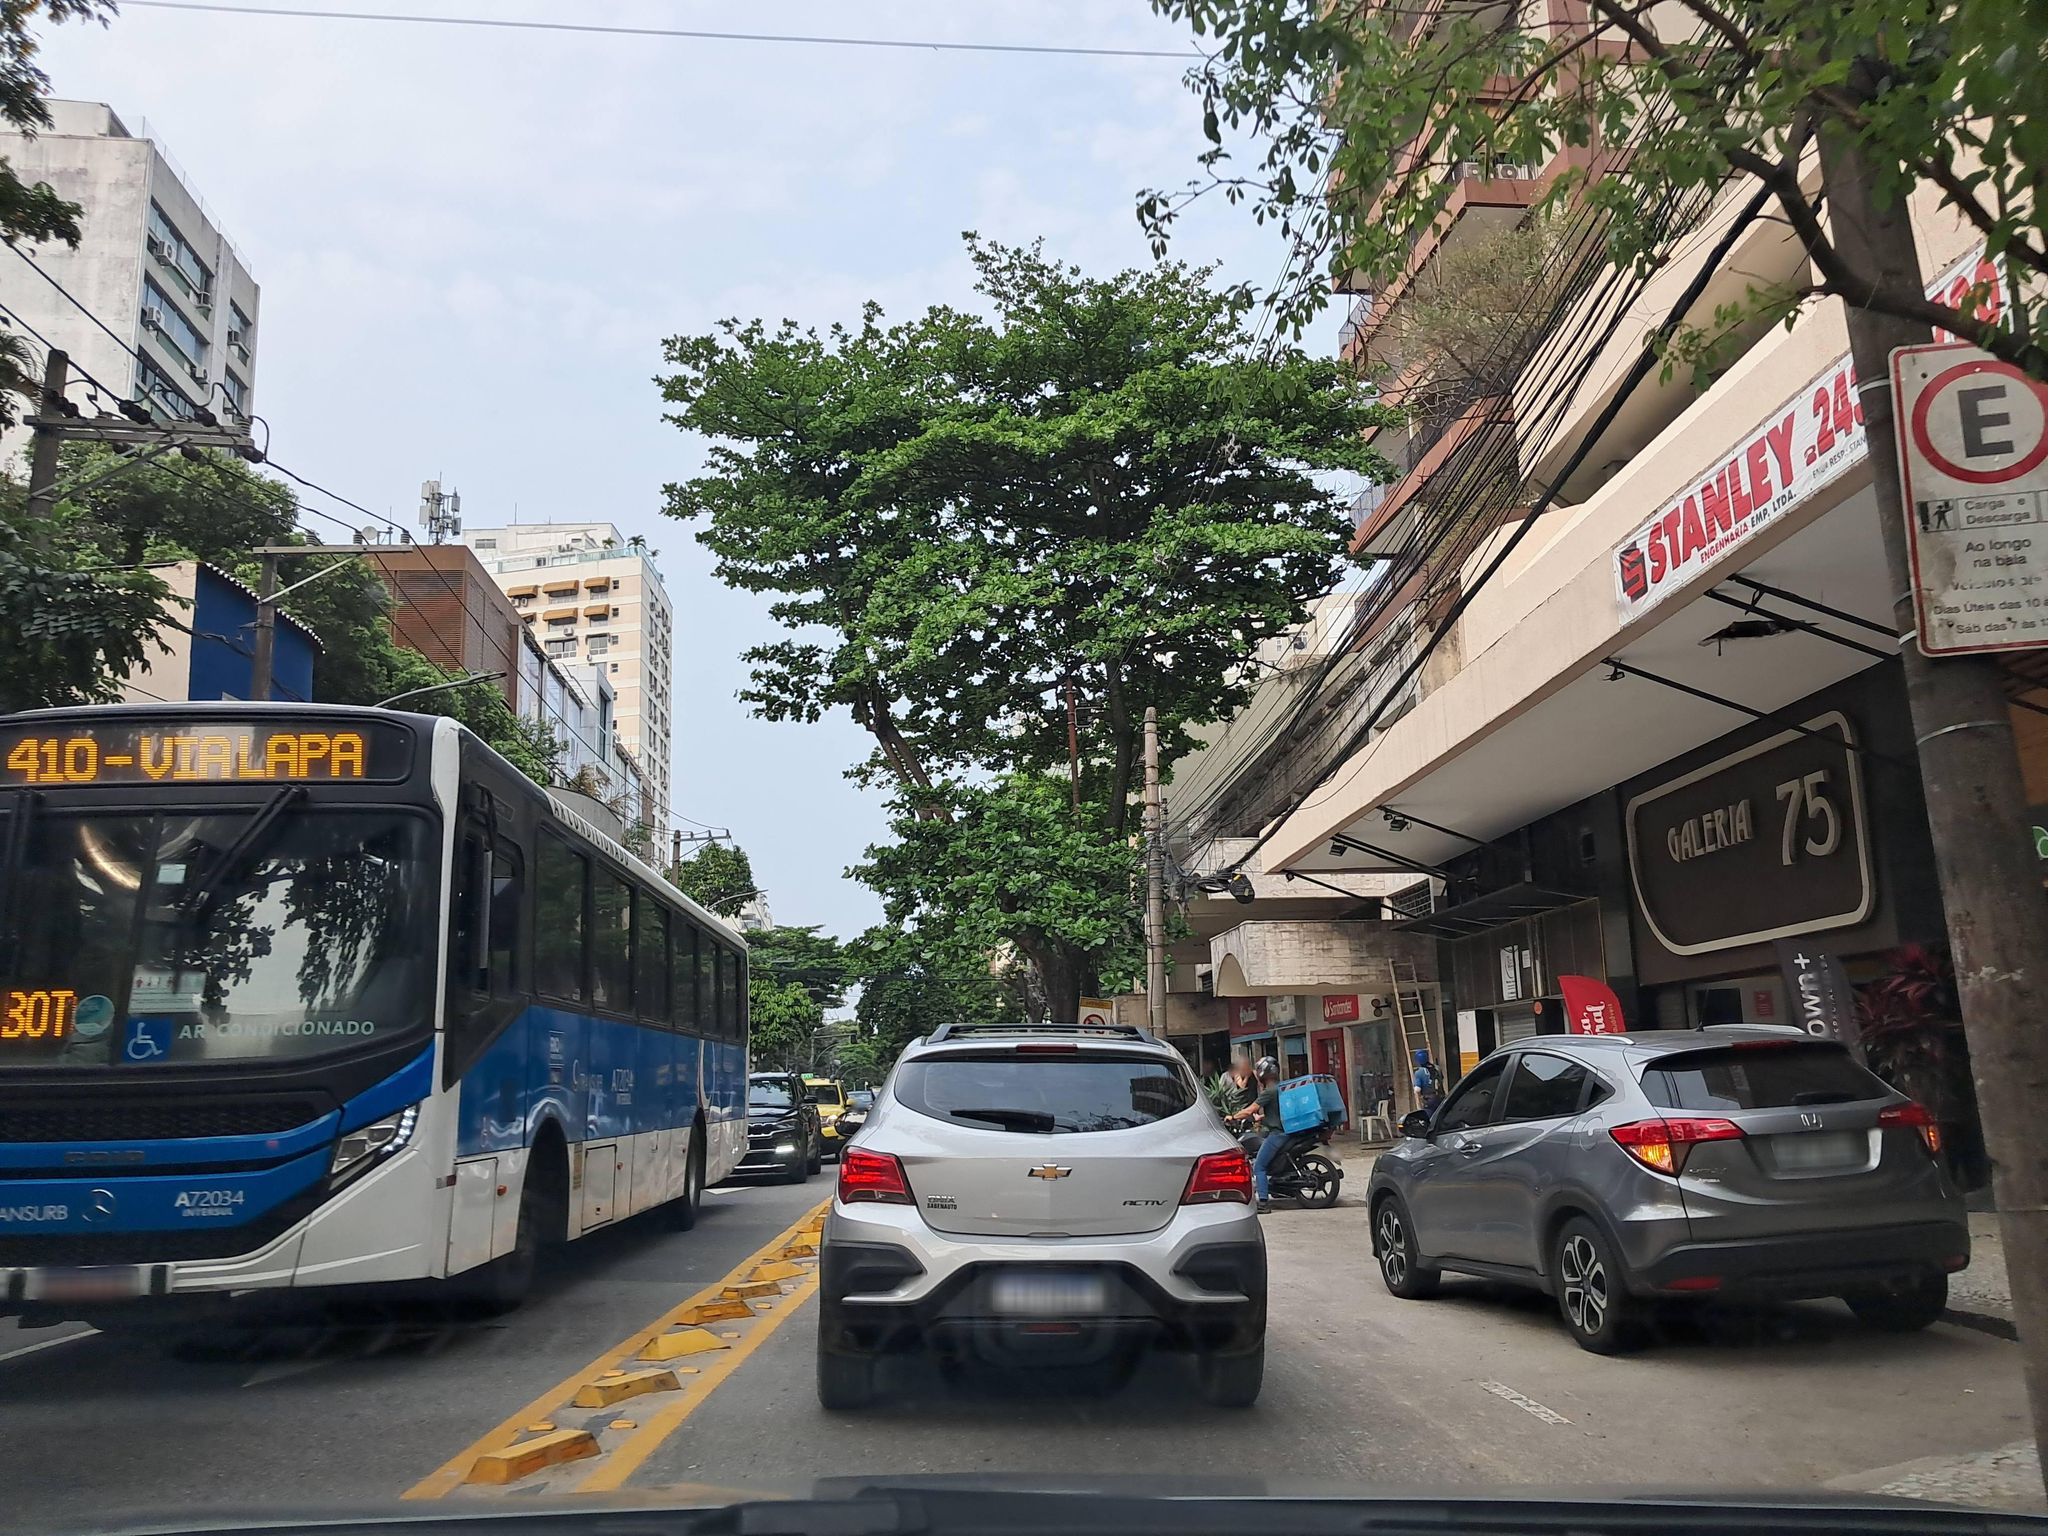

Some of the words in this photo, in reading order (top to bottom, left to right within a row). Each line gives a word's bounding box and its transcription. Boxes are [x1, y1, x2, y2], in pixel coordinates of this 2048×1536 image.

[1957, 385, 2014, 458] E
[1648, 411, 1795, 584] STANLEY
[1965, 499, 2005, 511] Carga
[2017, 498, 2026, 506] e
[1700, 523, 1749, 564] ENGENHARIA
[1750, 509, 1771, 528] EMP.
[1772, 489, 1797, 513] LTDA.
[1966, 511, 2030, 525] Descarga
[1965, 541, 1985, 552] Ao
[1989, 538, 2031, 551] longo
[1973, 557, 1992, 568] na
[1934, 605, 1960, 614] Dias
[1964, 601, 1995, 612] Úteis
[2000, 600, 2021, 609] das
[2025, 598, 2040, 608] 10
[1984, 622, 2007, 632] das
[6, 738, 98, 782] 410
[140, 735, 232, 780] VIA
[239, 733, 363, 778] LAPA
[1668, 799, 1752, 864] GALERIA
[1776, 770, 1841, 866] 75
[1, 990, 74, 1038] 30T
[178, 1024, 205, 1040] AR
[216, 1020, 375, 1038] CONDICIONADO
[174, 1190, 245, 1207] A72034
